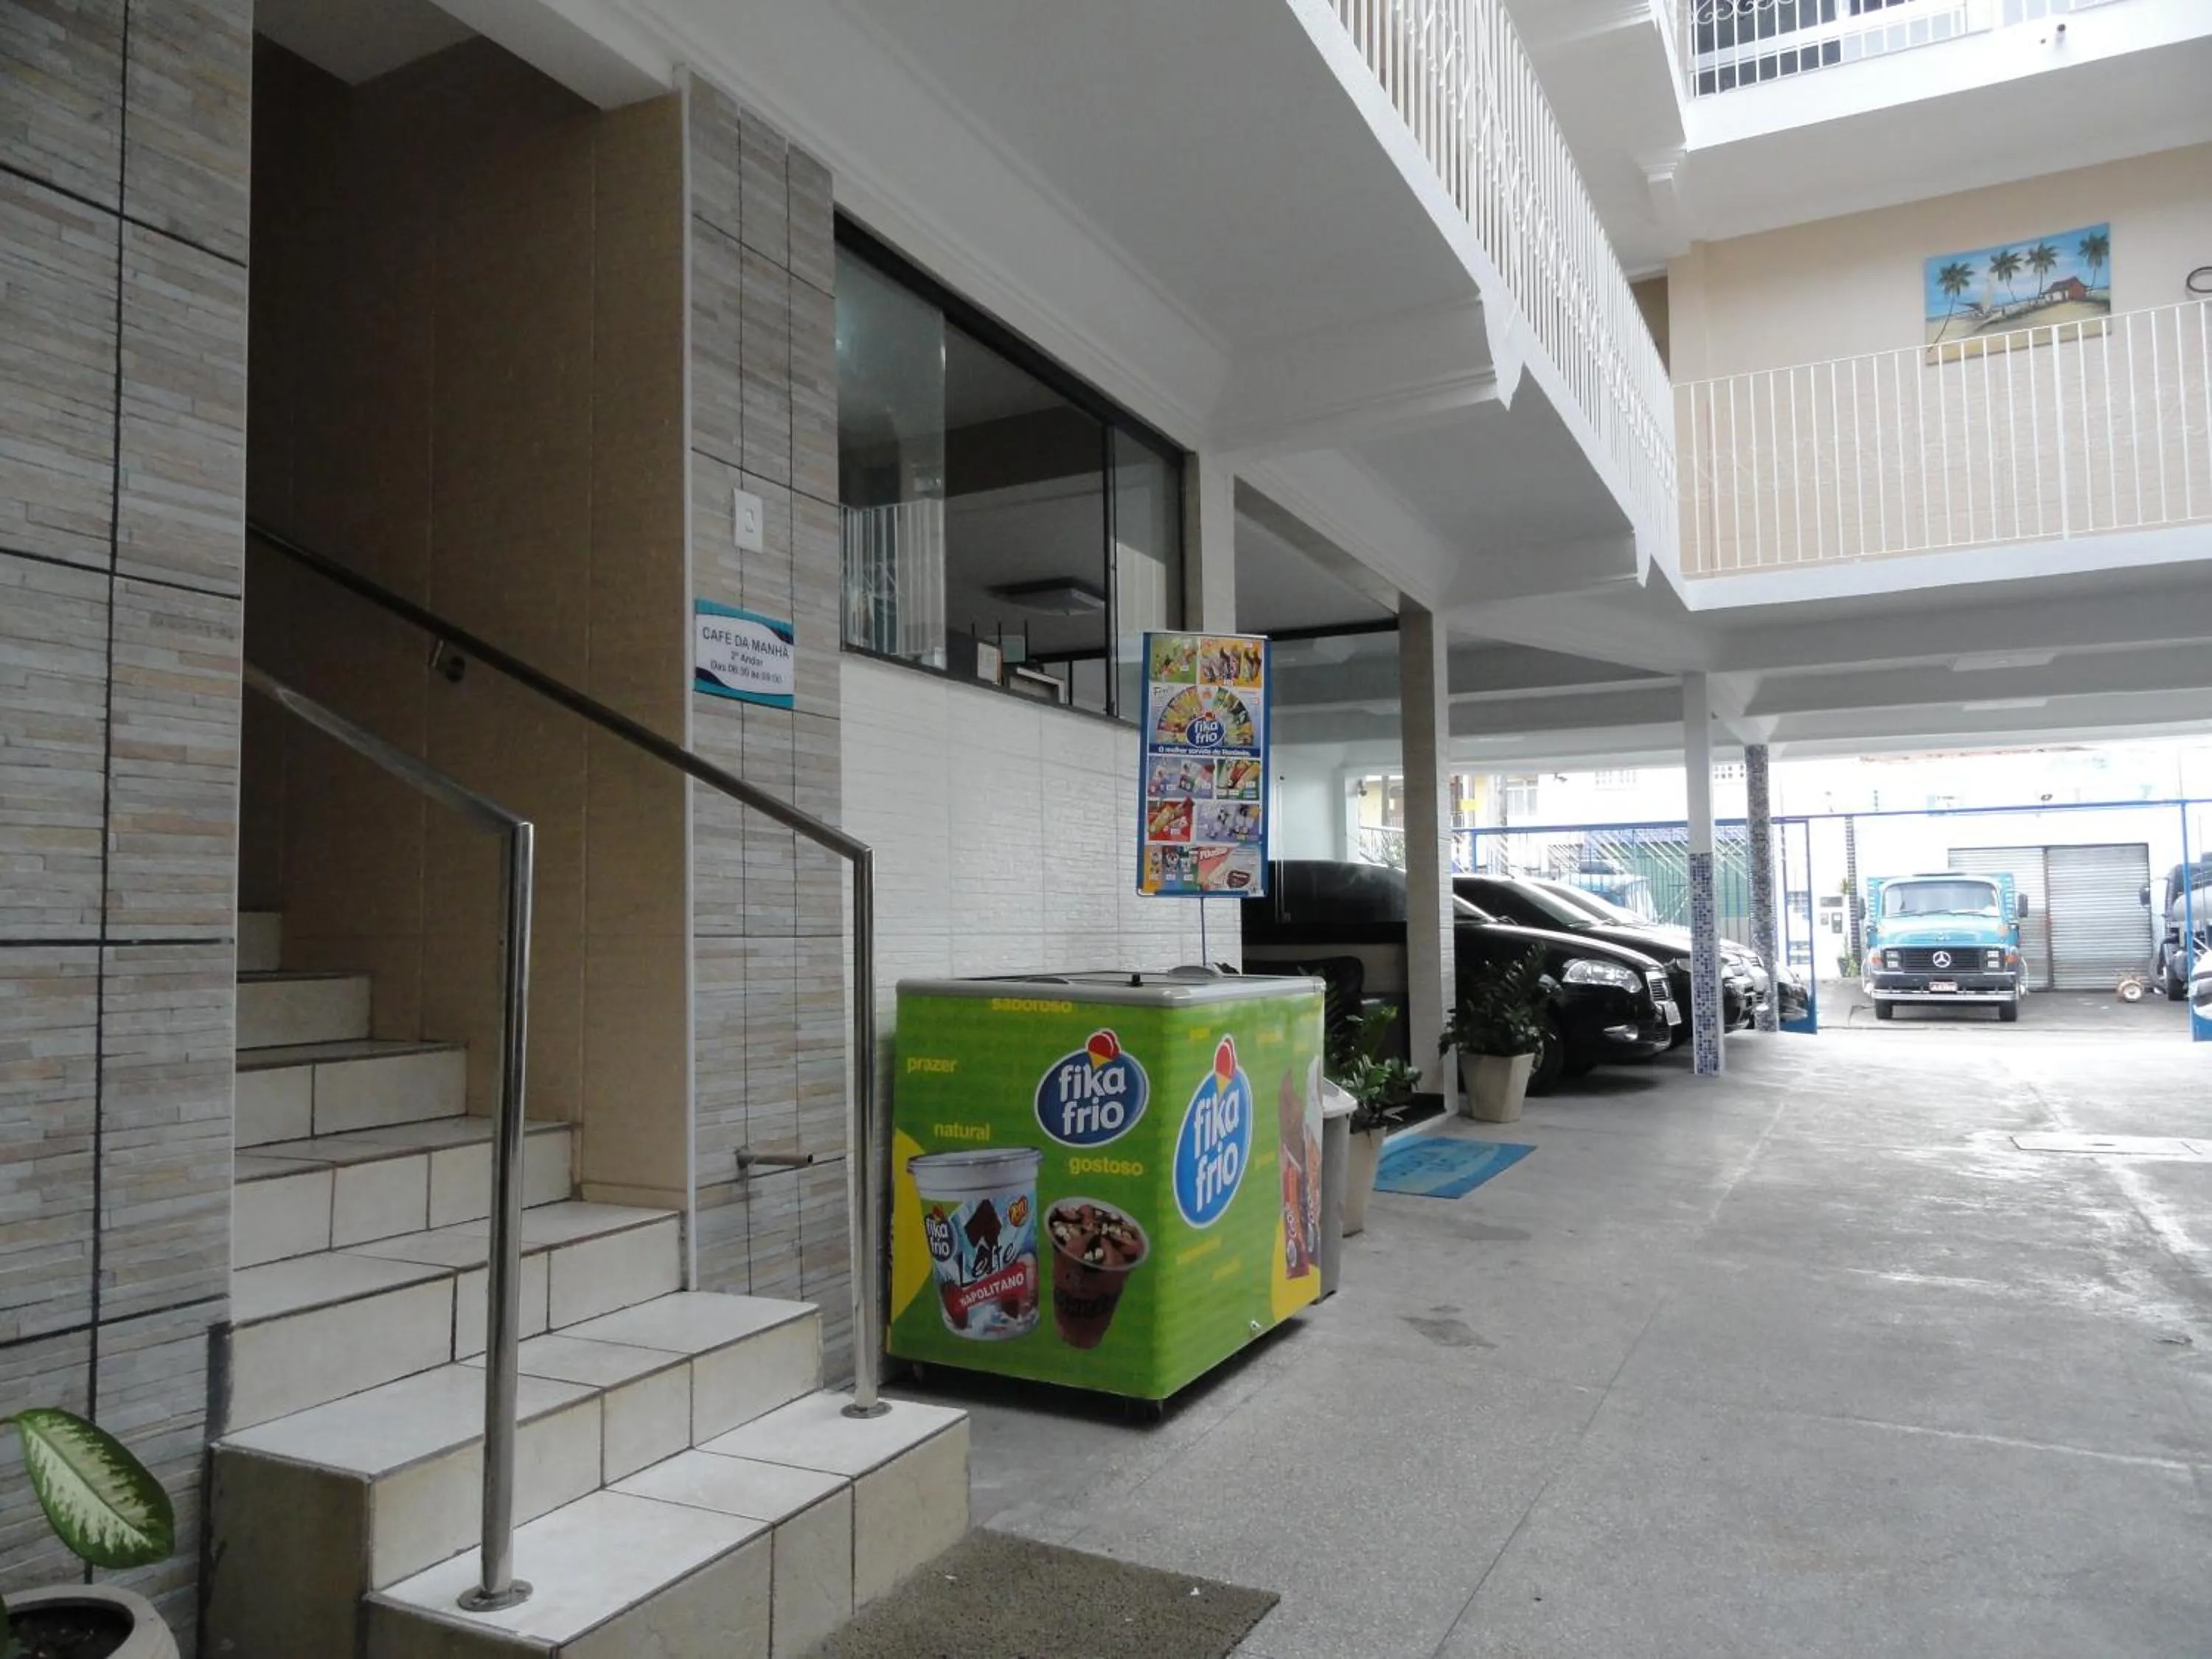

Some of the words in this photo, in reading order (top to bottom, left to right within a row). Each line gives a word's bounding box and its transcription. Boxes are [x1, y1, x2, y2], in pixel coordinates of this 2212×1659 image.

[735, 635, 749, 650] DA
[740, 654, 764, 666] Andar
[1194, 732, 1217, 744] frio
[992, 998, 1072, 1013] saboroso
[907, 1057, 957, 1074] prazer
[1059, 1064, 1127, 1102] fika
[1062, 1096, 1124, 1135] frio
[1194, 1087, 1239, 1159] fika
[934, 1121, 991, 1141] natural
[1068, 1158, 1144, 1176] gostoso
[1195, 1141, 1238, 1212] frio
[960, 1273, 1025, 1305] NAPOLITANO
